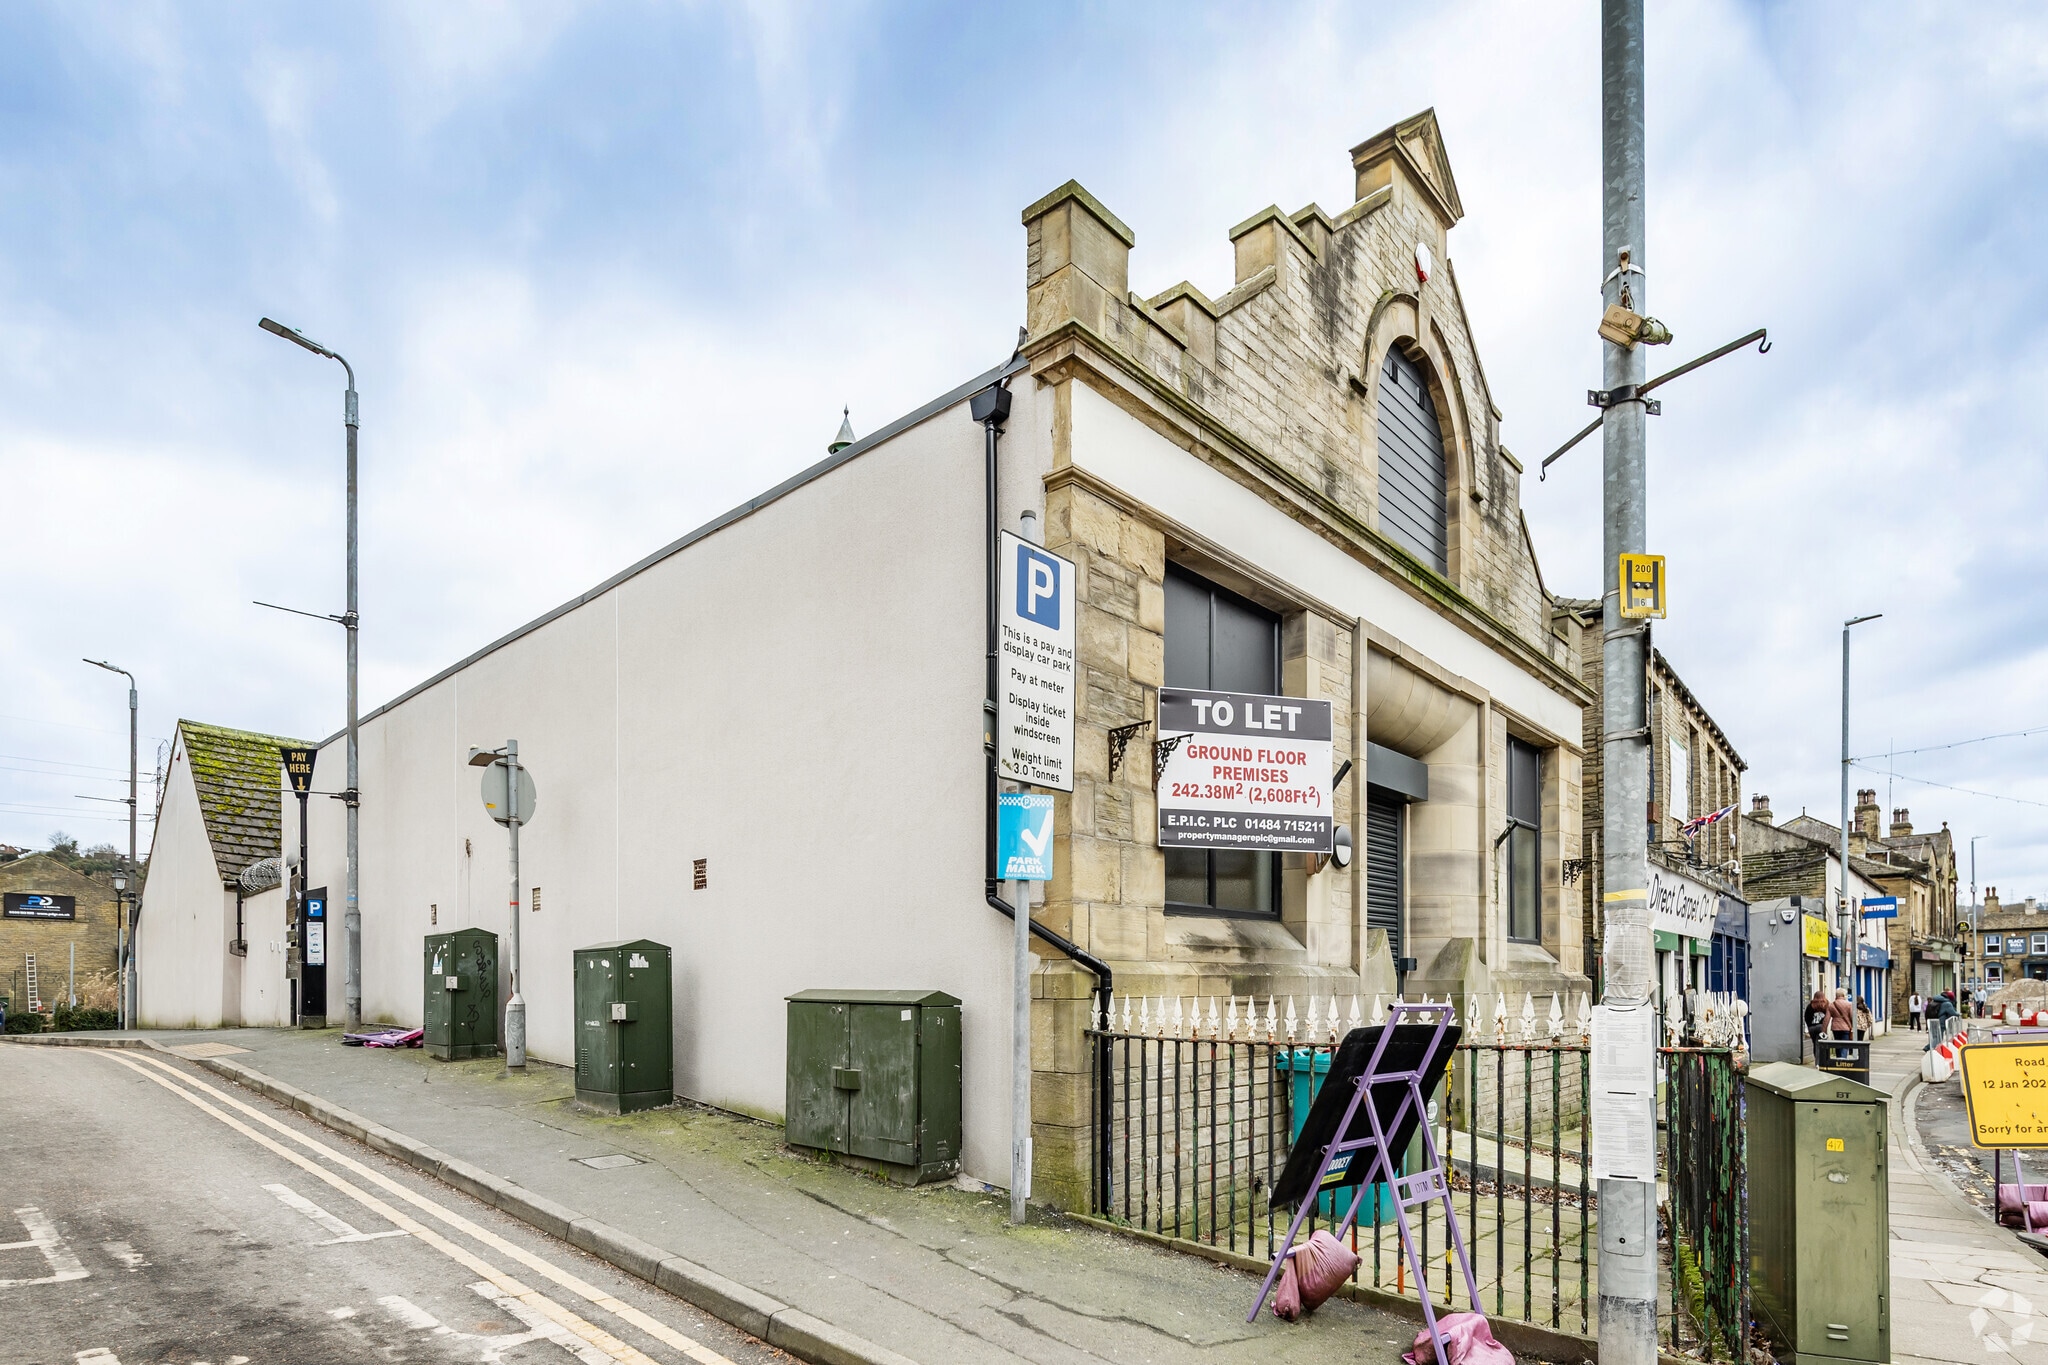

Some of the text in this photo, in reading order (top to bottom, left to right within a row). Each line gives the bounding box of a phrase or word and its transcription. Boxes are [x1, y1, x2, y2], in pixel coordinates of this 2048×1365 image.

[1635, 564, 1651, 573] 200
[1028, 556, 1054, 614] P
[1002, 624, 1072, 659] This is a pay and
[1004, 641, 1071, 672] display car park
[1011, 668, 1064, 693] Pay at meter
[1009, 692, 1066, 718] Display ticket
[1026, 712, 1050, 728] inside
[1192, 699, 1302, 731] TO LET
[1014, 725, 1060, 744] windscreen
[291, 752, 306, 762] PAY
[1012, 747, 1062, 770] Weight limit
[1187, 744, 1306, 765] GROUND FLOOR
[290, 764, 310, 773] HERE
[1014, 762, 1060, 782] 3.0 Tonnes
[1213, 766, 1288, 783] PREMISES
[1168, 815, 1325, 832] E.P.I.C. PLC 01484 715211
[1178, 832, 1315, 844] propertymanagerepic@gmail.com
[1006, 864, 1045, 873] MARK
[1008, 856, 1042, 864] PARK
[310, 901, 320, 914] P
[1650, 873, 1675, 915] Direct
[1676, 884, 1699, 928] Carpet
[2015, 1058, 2045, 1066] Road
[1983, 1079, 2048, 1088] 12 Jan 202
[1980, 1125, 2011, 1134] Sorry
[2015, 1124, 2032, 1133] for
[1415, 1181, 1428, 1193] DTM
